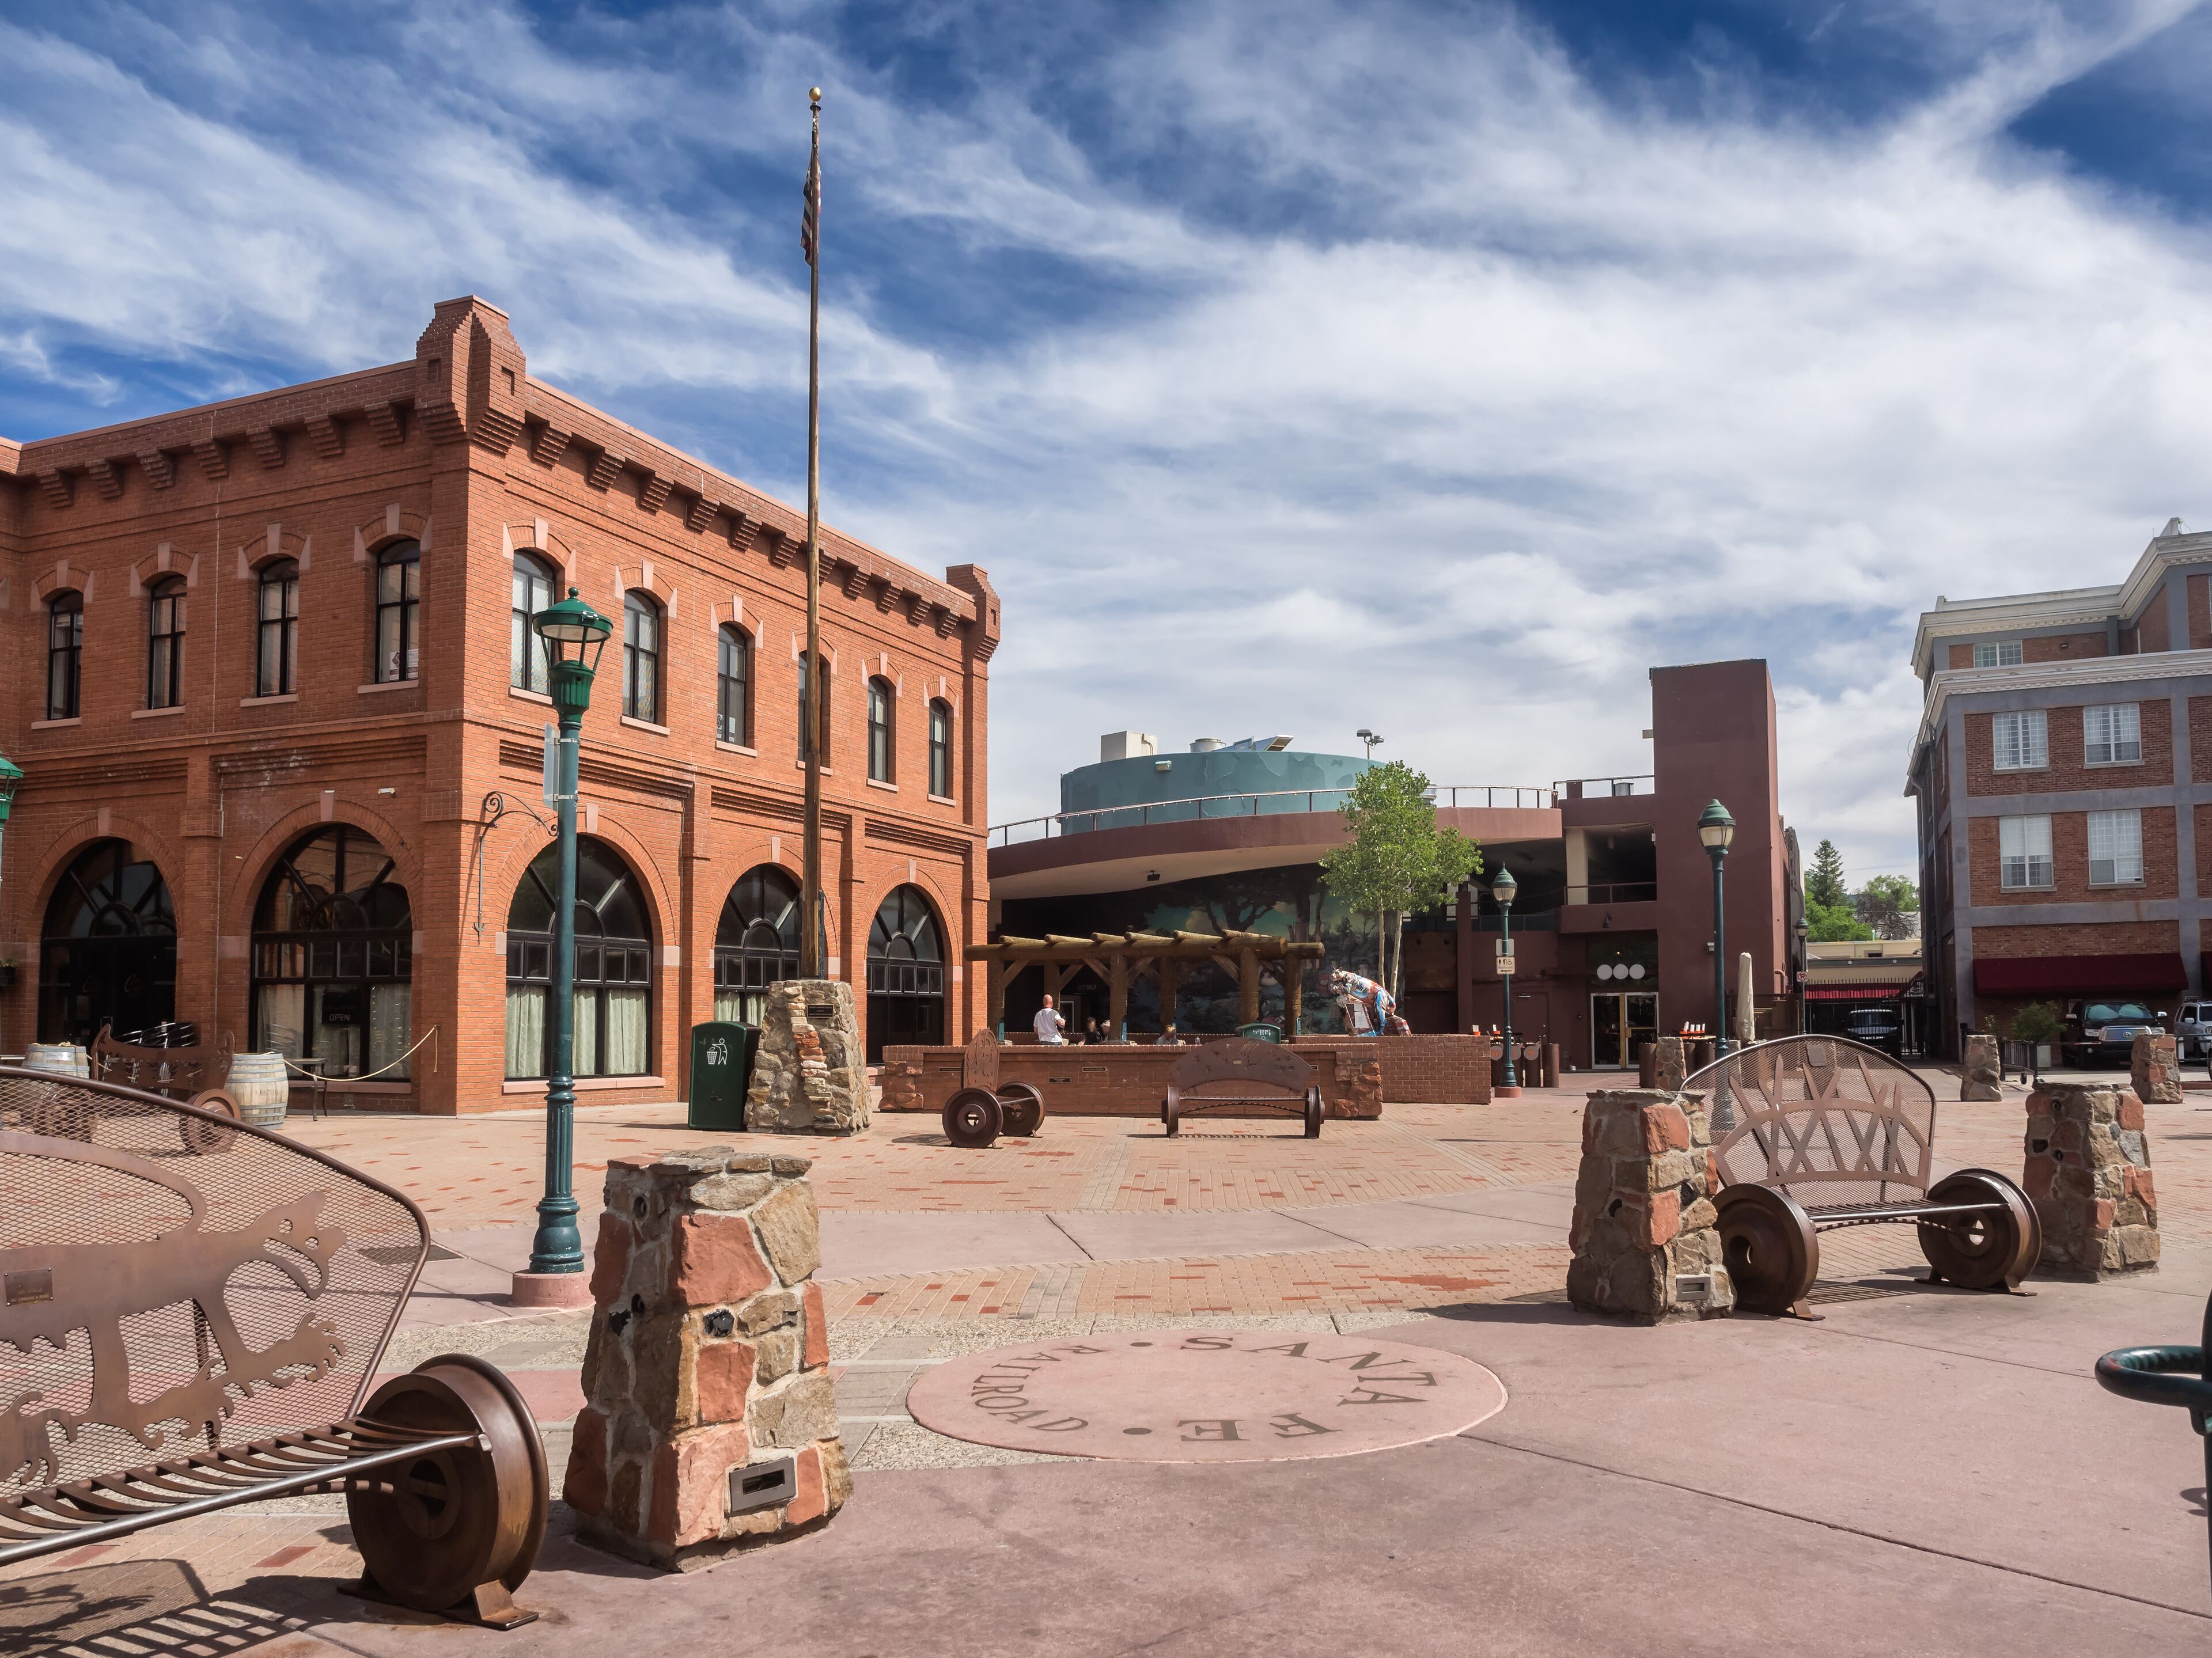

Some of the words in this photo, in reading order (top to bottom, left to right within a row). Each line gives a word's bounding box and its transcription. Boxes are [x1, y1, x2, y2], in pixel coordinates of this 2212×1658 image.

[971, 1345, 1108, 1432] RAILROAD
[1180, 1337, 1438, 1407] SANTA
[1176, 1412, 1343, 1442] FE
